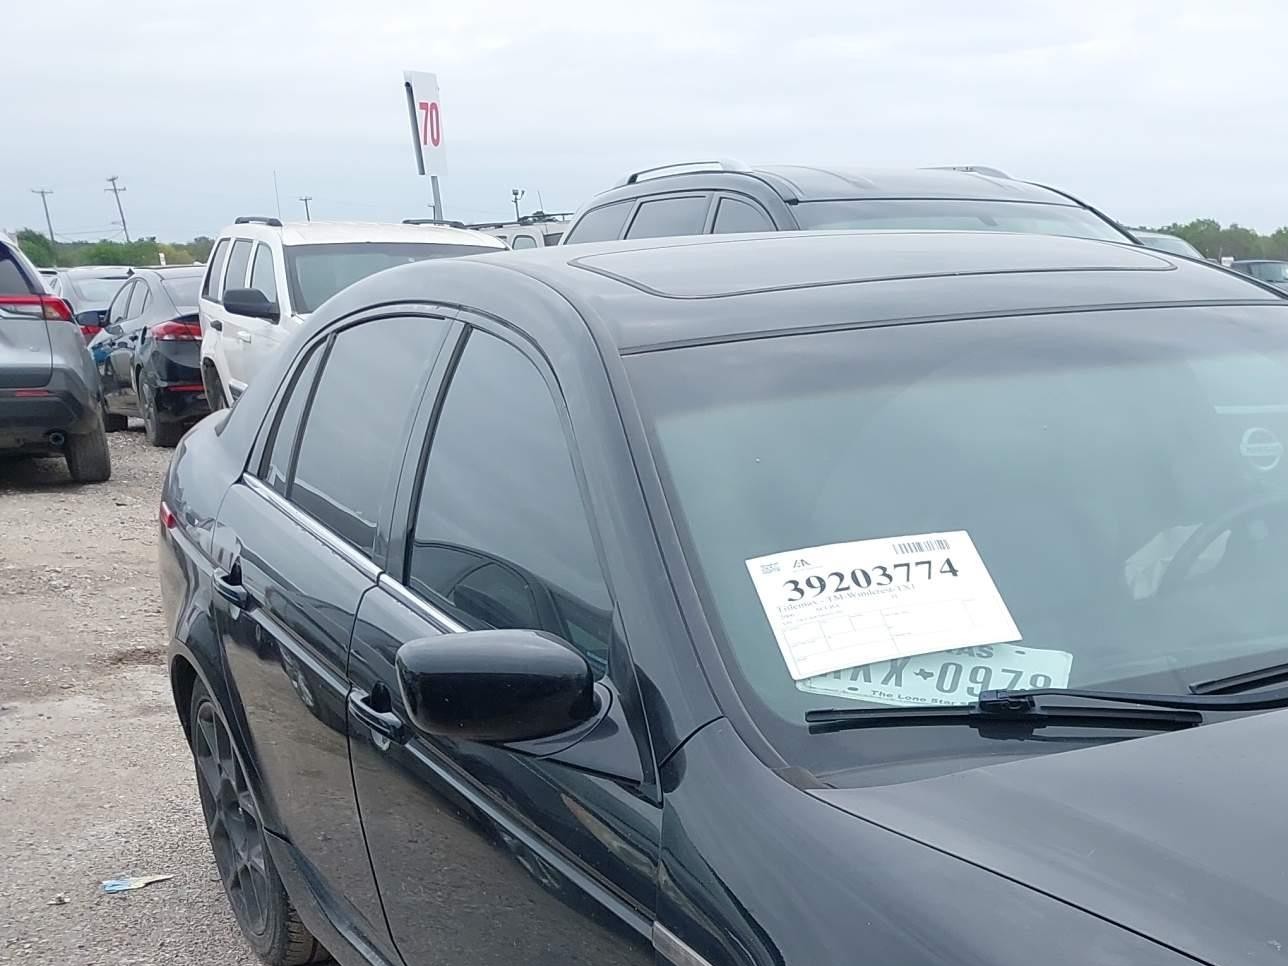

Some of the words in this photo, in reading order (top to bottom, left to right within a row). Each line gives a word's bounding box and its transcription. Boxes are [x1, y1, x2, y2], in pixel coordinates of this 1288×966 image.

[419, 101, 441, 147] 70
[783, 557, 959, 602] 39203774
[871, 690, 894, 698] The
[897, 693, 927, 702] Lone
[930, 697, 957, 705] Star
